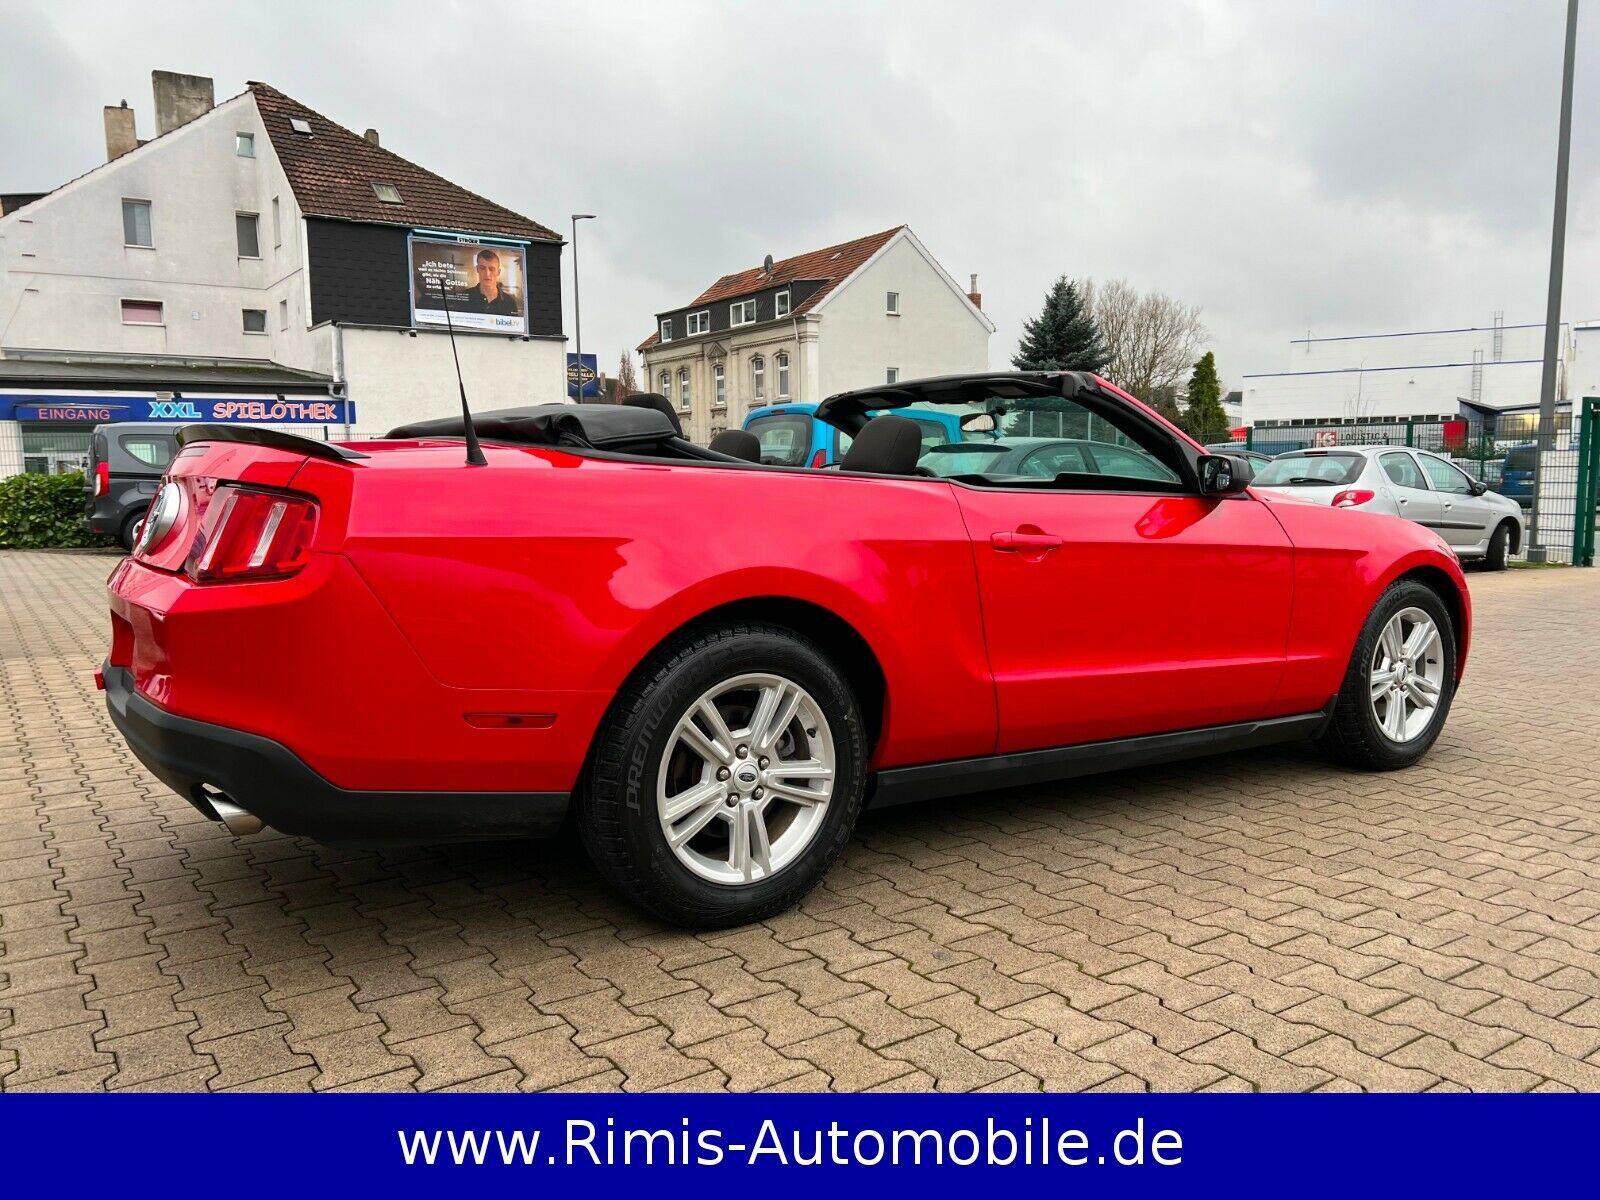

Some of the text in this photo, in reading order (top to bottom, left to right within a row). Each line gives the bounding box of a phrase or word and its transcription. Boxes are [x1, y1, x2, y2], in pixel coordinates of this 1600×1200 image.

[426, 277, 468, 287] Näh Gottes
[38, 408, 111, 420] EINGANG
[148, 401, 338, 420] XXL SPIELOTHEK
